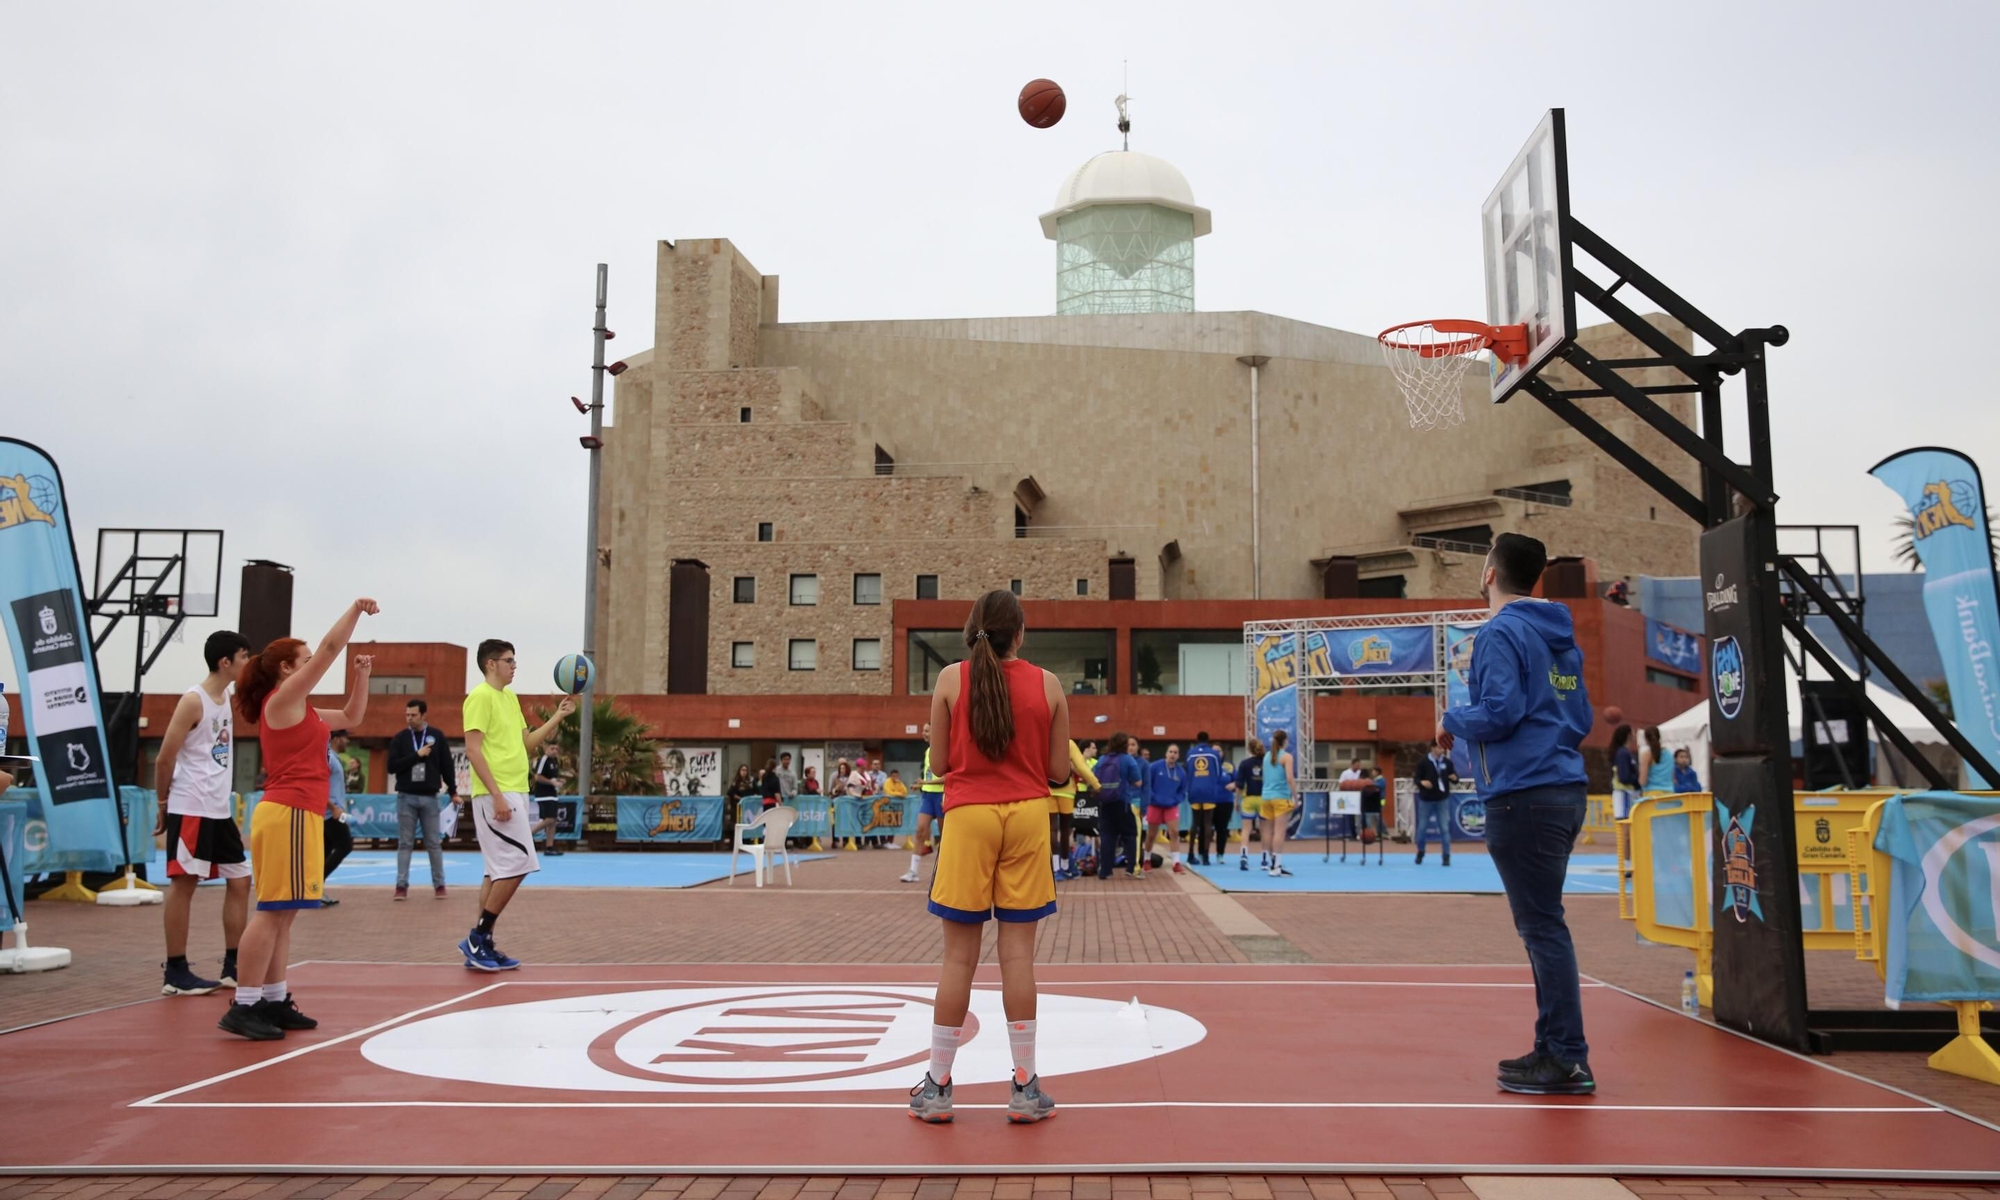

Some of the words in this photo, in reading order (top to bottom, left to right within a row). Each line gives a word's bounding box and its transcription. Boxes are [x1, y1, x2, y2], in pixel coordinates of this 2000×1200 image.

[1707, 584, 1738, 610] SPALDING
[690, 751, 716, 766] PURA
[668, 815, 696, 831] NEXT
[879, 811, 903, 826] NEXT
[1804, 845, 1829, 853] Cabildo
[648, 1002, 906, 1064] KIA
